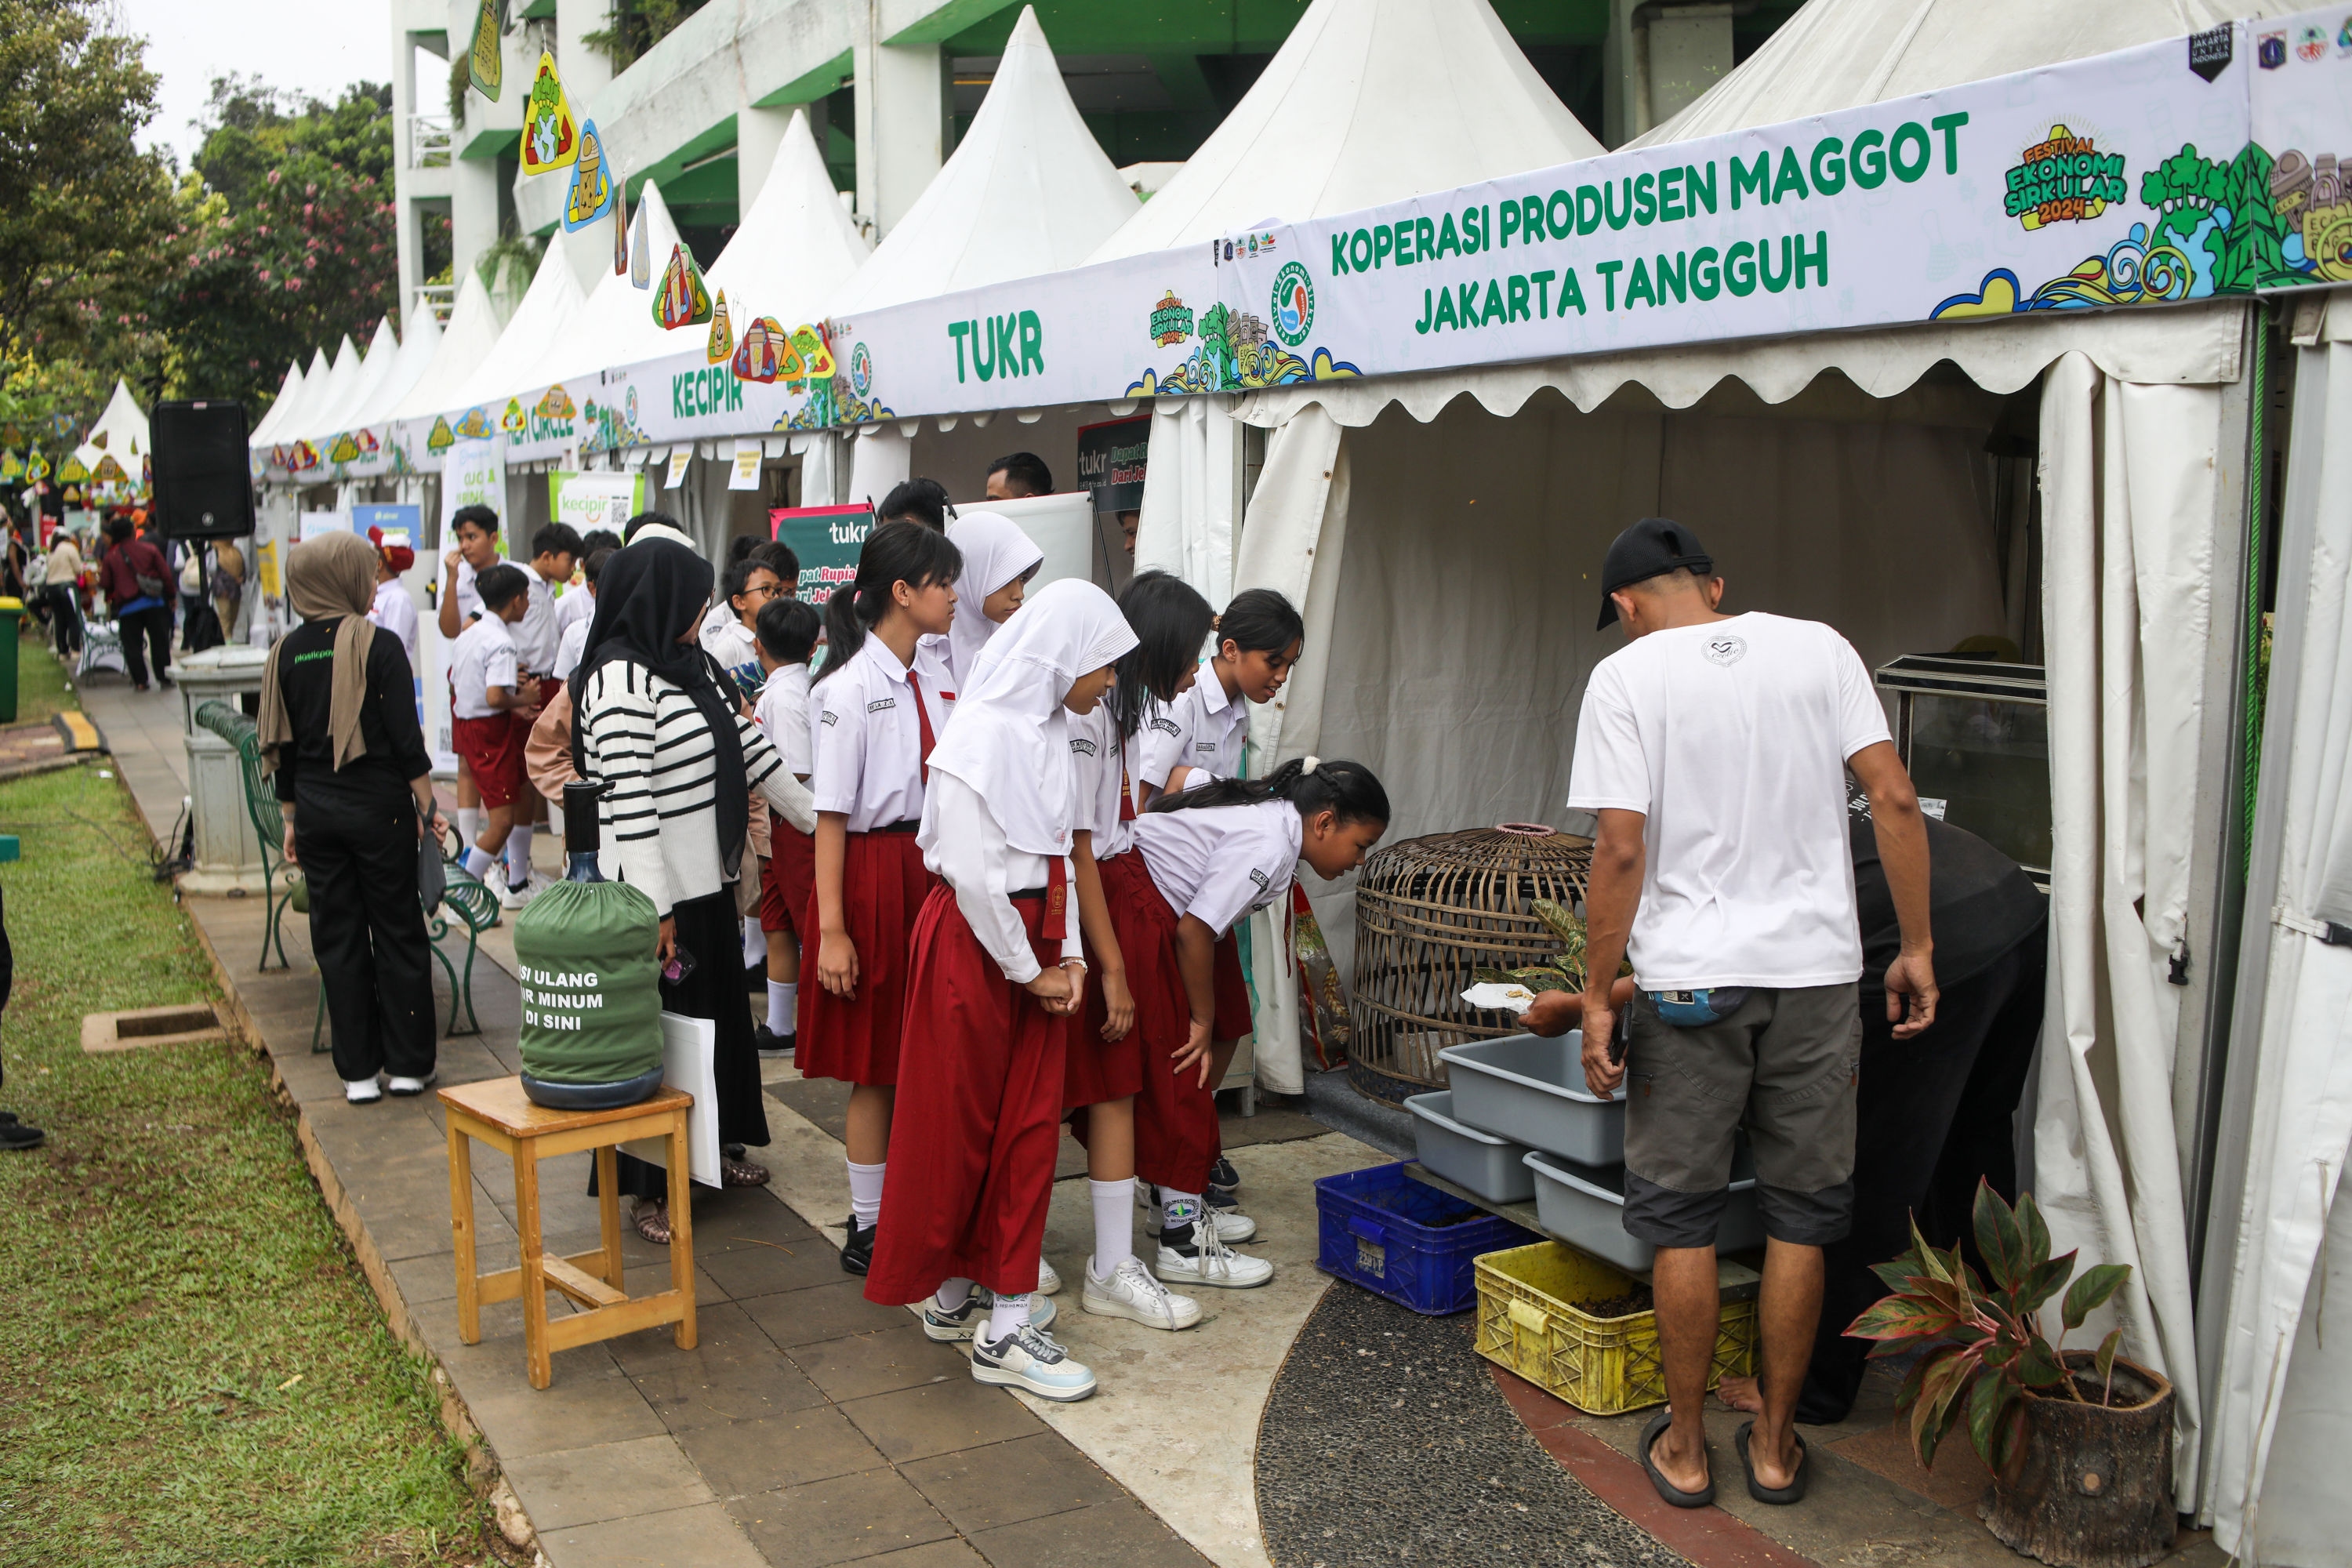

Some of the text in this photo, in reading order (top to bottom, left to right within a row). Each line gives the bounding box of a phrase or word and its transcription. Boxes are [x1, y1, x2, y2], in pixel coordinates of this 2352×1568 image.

[2192, 34, 2230, 49] JAKARTA
[2192, 45, 2230, 56] UNTUK
[2192, 52, 2230, 64] INDONESIA
[2022, 136, 2096, 165] FESTIVAL
[2005, 152, 2125, 194] EKONOMI
[1332, 111, 1969, 277] KOPERASI PRODUSEN MAGGOT
[2003, 176, 2128, 218] SIRKULAR
[2038, 198, 2085, 225] 2024
[1414, 230, 1828, 335] JAKARTA TANGGUH
[1156, 297, 1183, 311] FESTIVAL
[1149, 307, 1193, 326] EKONOMI
[1149, 319, 1194, 340] SIRKULAR
[1162, 331, 1180, 346] 2024
[949, 310, 1044, 384] TUKR
[673, 366, 743, 419] KECIPIR
[532, 403, 574, 443] CIRCLE
[1079, 449, 1107, 476] tukr
[1110, 443, 1141, 466] Dapat
[1111, 465, 1134, 485] Dari
[562, 495, 608, 514] kecipir
[829, 521, 869, 544] tukr
[821, 564, 859, 584] Rupia
[534, 969, 598, 988] ULANG
[538, 991, 603, 1009] MINUM
[525, 1009, 581, 1031] DI SINI
